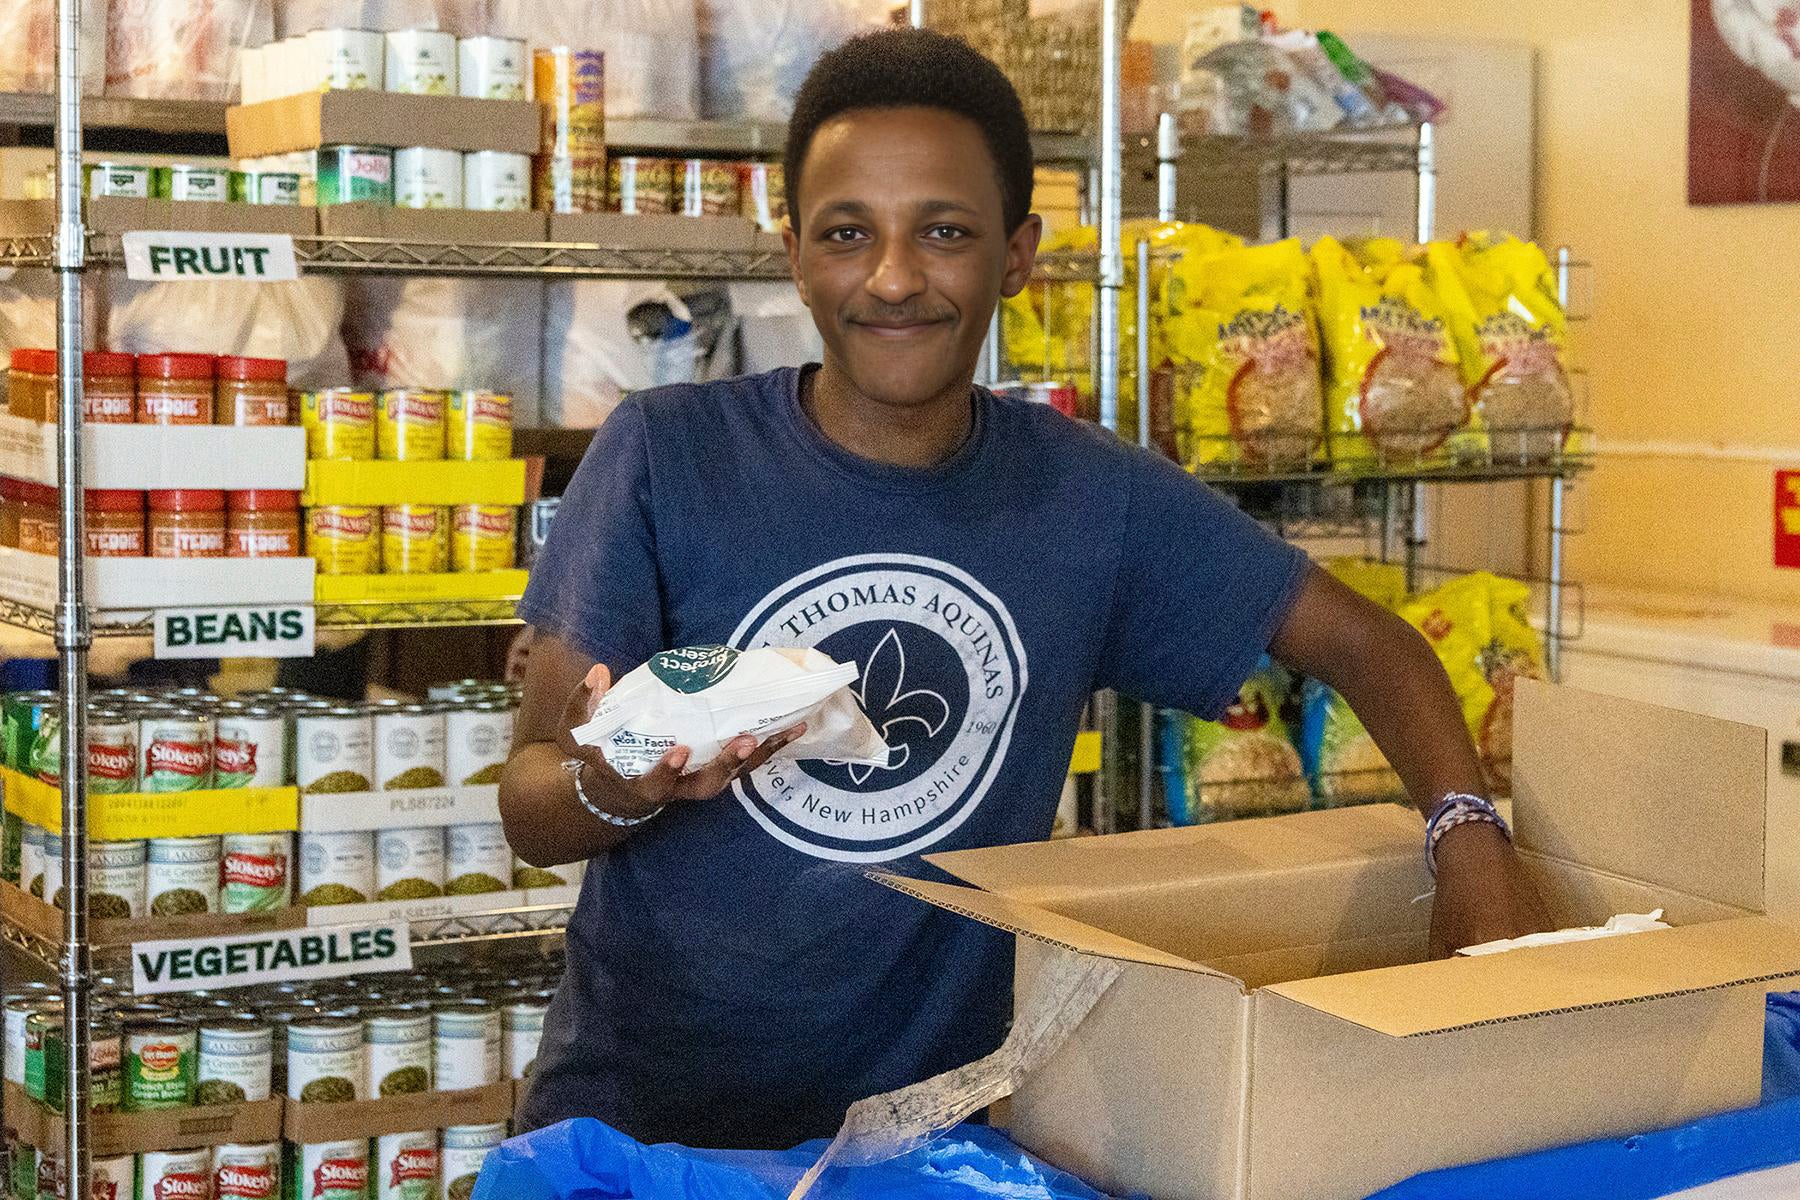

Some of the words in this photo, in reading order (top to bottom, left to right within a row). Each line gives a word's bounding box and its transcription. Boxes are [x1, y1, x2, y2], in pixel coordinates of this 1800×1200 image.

[149, 245, 270, 275] FRUIT
[165, 608, 305, 647] BEANS
[780, 583, 917, 639] THOMAS
[923, 592, 1004, 701] AQUINAS
[659, 650, 728, 676] project
[965, 719, 998, 736] 1960
[90, 744, 134, 769] okely's
[644, 738, 677, 748] Facts
[763, 760, 796, 801] ver,
[802, 793, 852, 824] New
[861, 754, 971, 825] Hampshire
[138, 926, 397, 983] VEGETABLES
